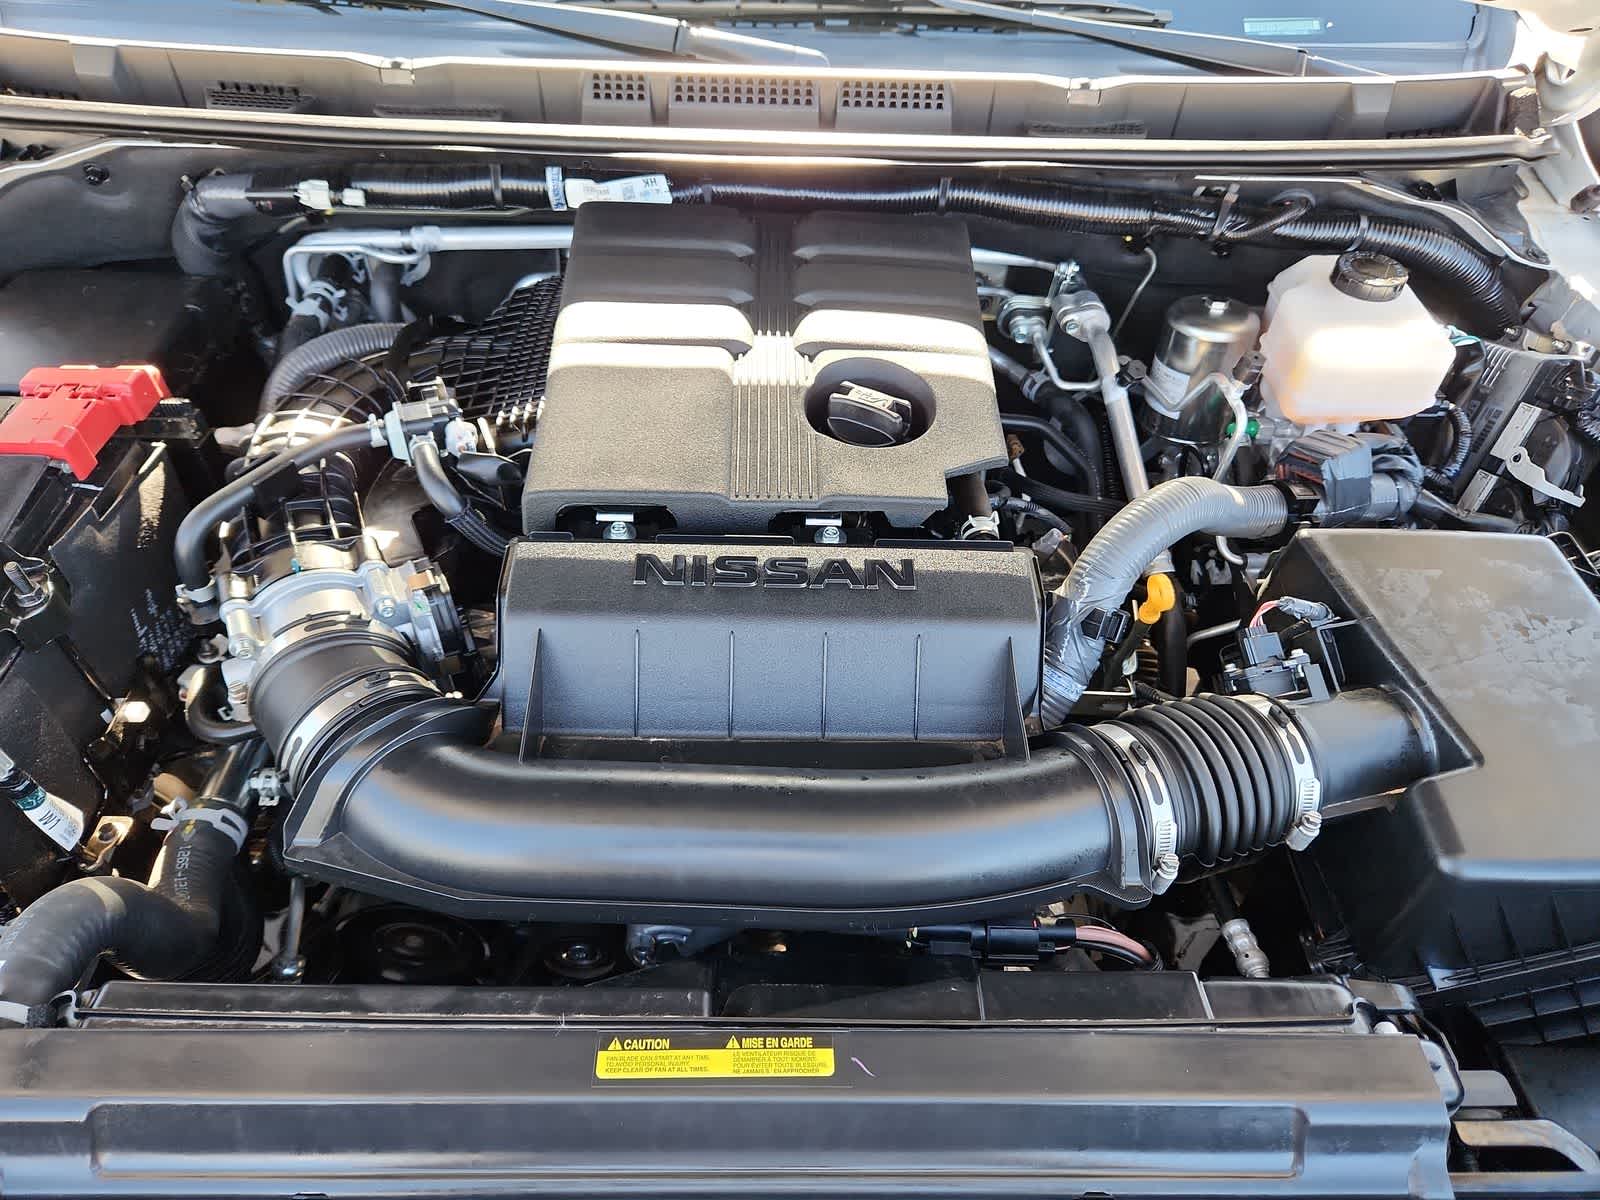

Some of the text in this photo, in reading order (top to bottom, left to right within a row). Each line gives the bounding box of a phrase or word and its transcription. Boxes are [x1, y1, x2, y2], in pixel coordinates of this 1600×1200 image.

[642, 178, 658, 188] HK
[632, 553, 917, 590] NISSAN
[623, 1038, 670, 1049] CAUTION
[741, 1037, 813, 1048] MISE EN GARDE
